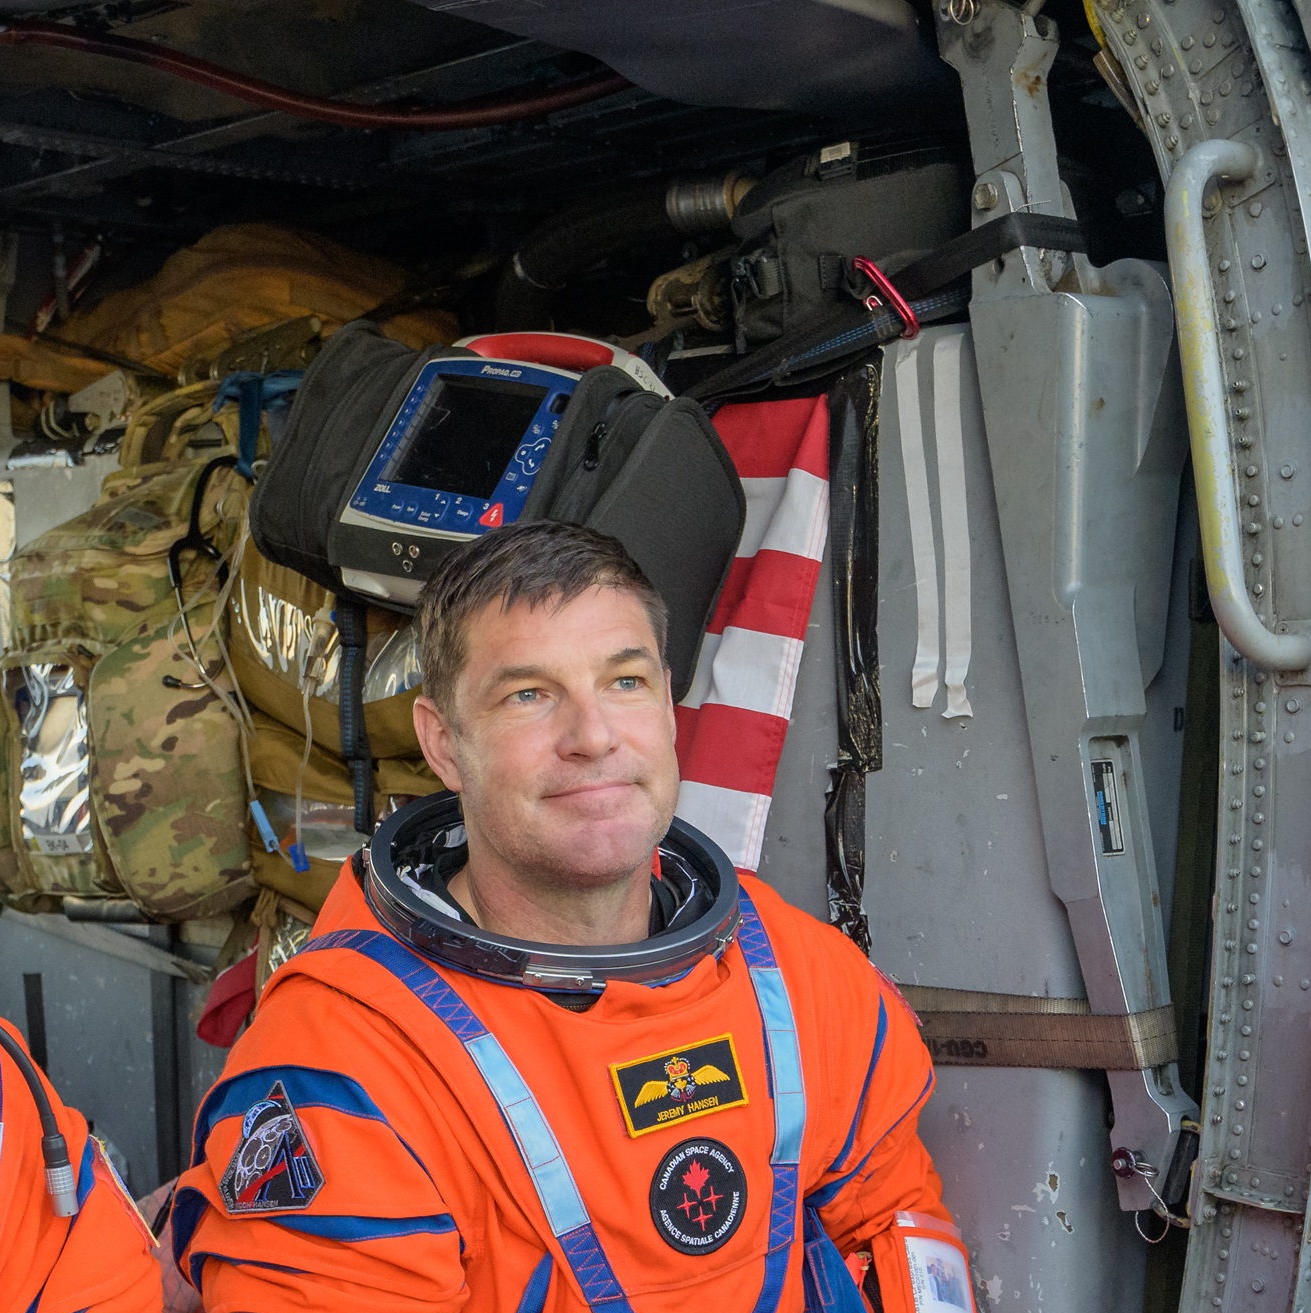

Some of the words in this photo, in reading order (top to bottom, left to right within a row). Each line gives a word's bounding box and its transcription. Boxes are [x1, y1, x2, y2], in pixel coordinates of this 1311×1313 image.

[373, 483, 391, 493] ZOLL
[656, 1105, 685, 1122] JEREMY
[687, 1096, 719, 1113] HANSEN
[659, 1151, 686, 1191] CANADIAN
[685, 1146, 709, 1157] SPACE
[709, 1149, 735, 1173] AGENCY
[660, 1209, 682, 1239] AGENCE
[680, 1234, 714, 1246] SPATIALE
[714, 1191, 740, 1239] CANADIENNE
